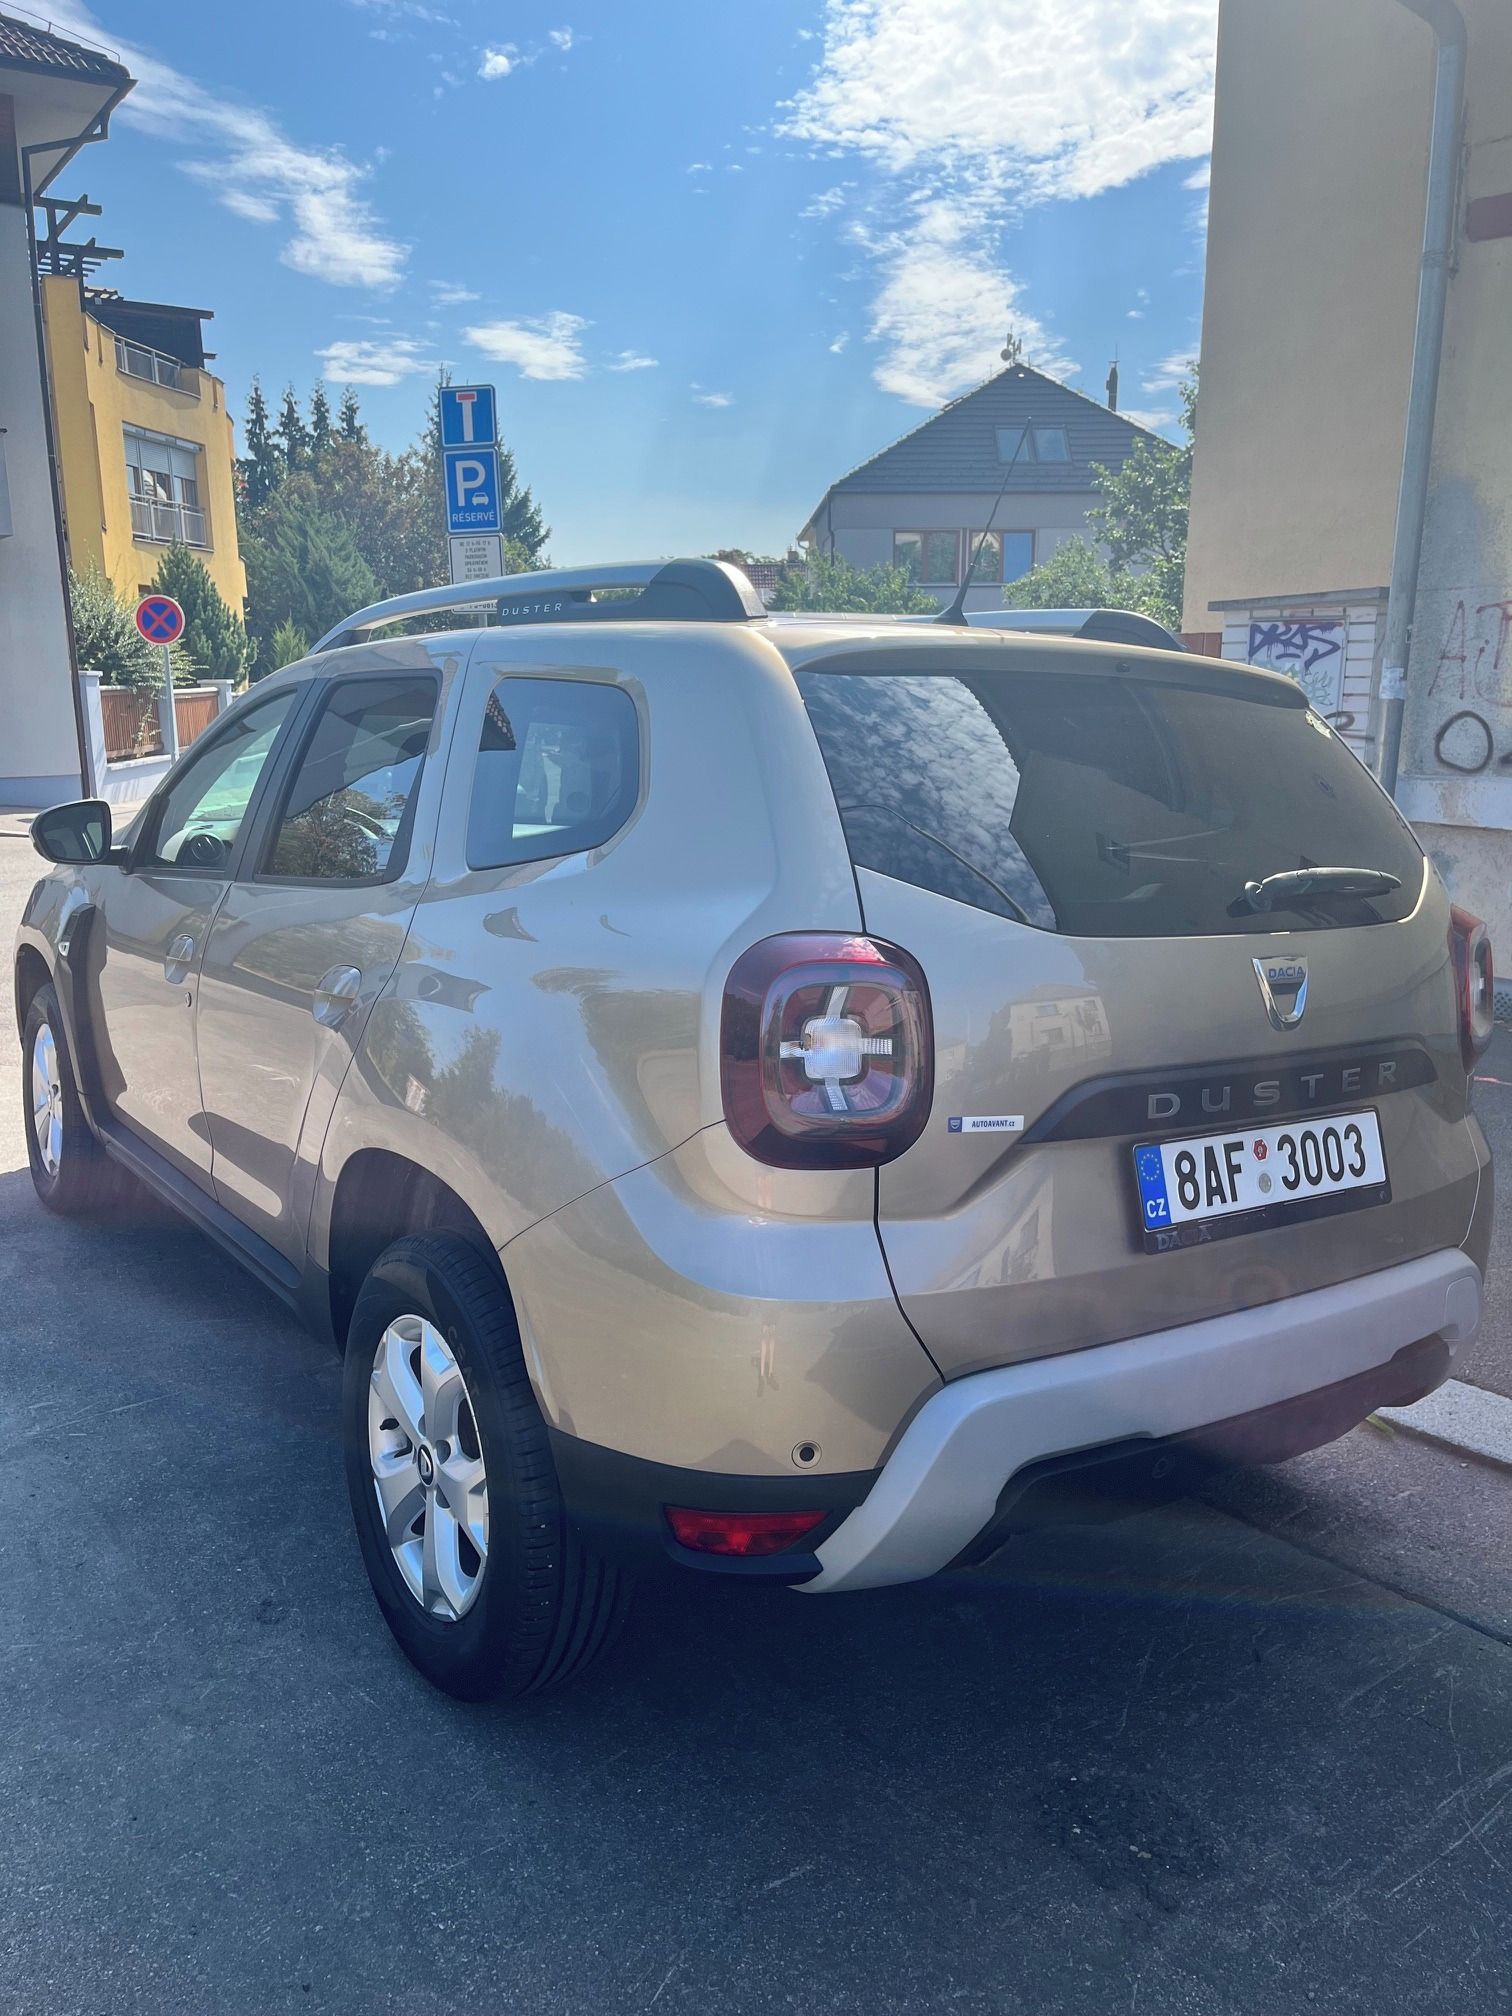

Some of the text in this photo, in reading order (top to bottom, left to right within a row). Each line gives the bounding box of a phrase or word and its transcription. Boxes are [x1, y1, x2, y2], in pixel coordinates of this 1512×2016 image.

[455, 460, 486, 507] P
[502, 603, 562, 616] DUSTER
[1268, 966, 1305, 978] DACIA
[1147, 1061, 1397, 1120] DUSTER
[1174, 1123, 1366, 1211] 8AF 3003
[1146, 1198, 1167, 1218] CZ
